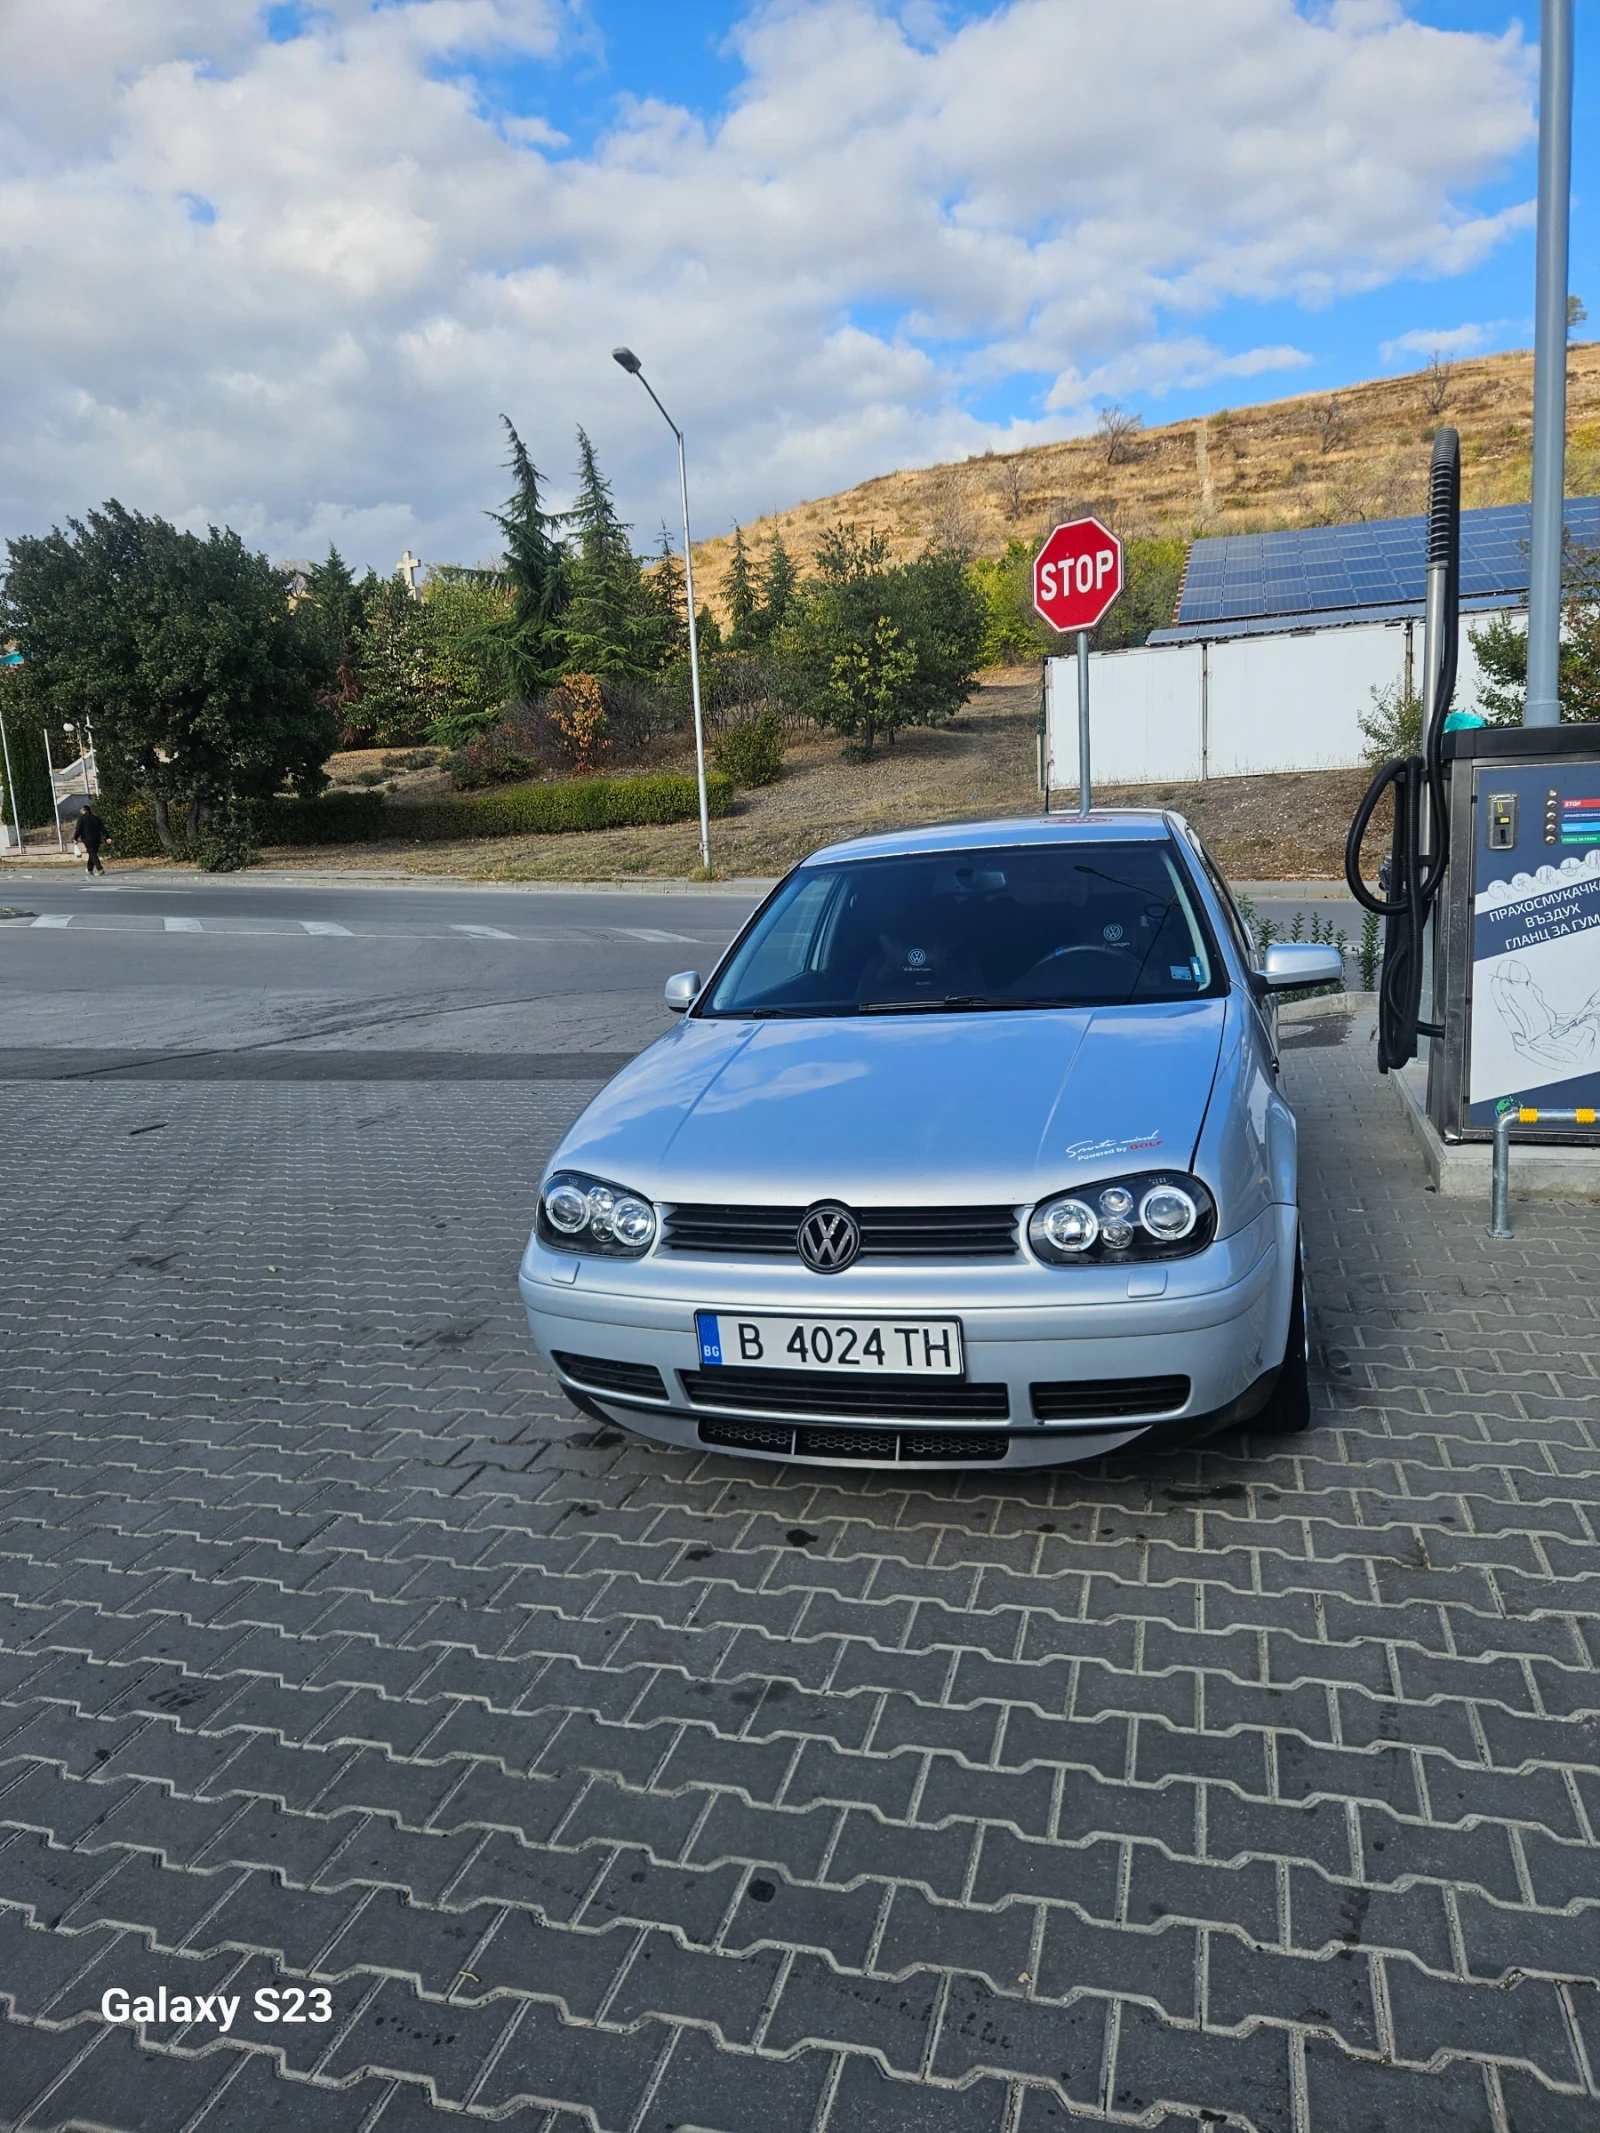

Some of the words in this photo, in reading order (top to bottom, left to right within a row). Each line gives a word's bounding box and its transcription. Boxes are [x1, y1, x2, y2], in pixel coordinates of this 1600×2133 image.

[1041, 549, 1114, 602] STOP
[1563, 800, 1582, 808] STOP
[1489, 880, 1600, 923] ПРАХОСМУКАЧК
[1525, 903, 1581, 928] ВЪЗДУХ
[1505, 929, 1551, 950] ГЛАНЦ
[1551, 923, 1571, 937] ЗА
[1077, 1147, 1115, 1161] Powered
[1116, 1146, 1127, 1154] by
[1129, 1139, 1163, 1151] GOLF
[703, 1344, 720, 1357] BG
[738, 1322, 764, 1361] B
[786, 1322, 886, 1366] 4024
[894, 1327, 952, 1368] TH
